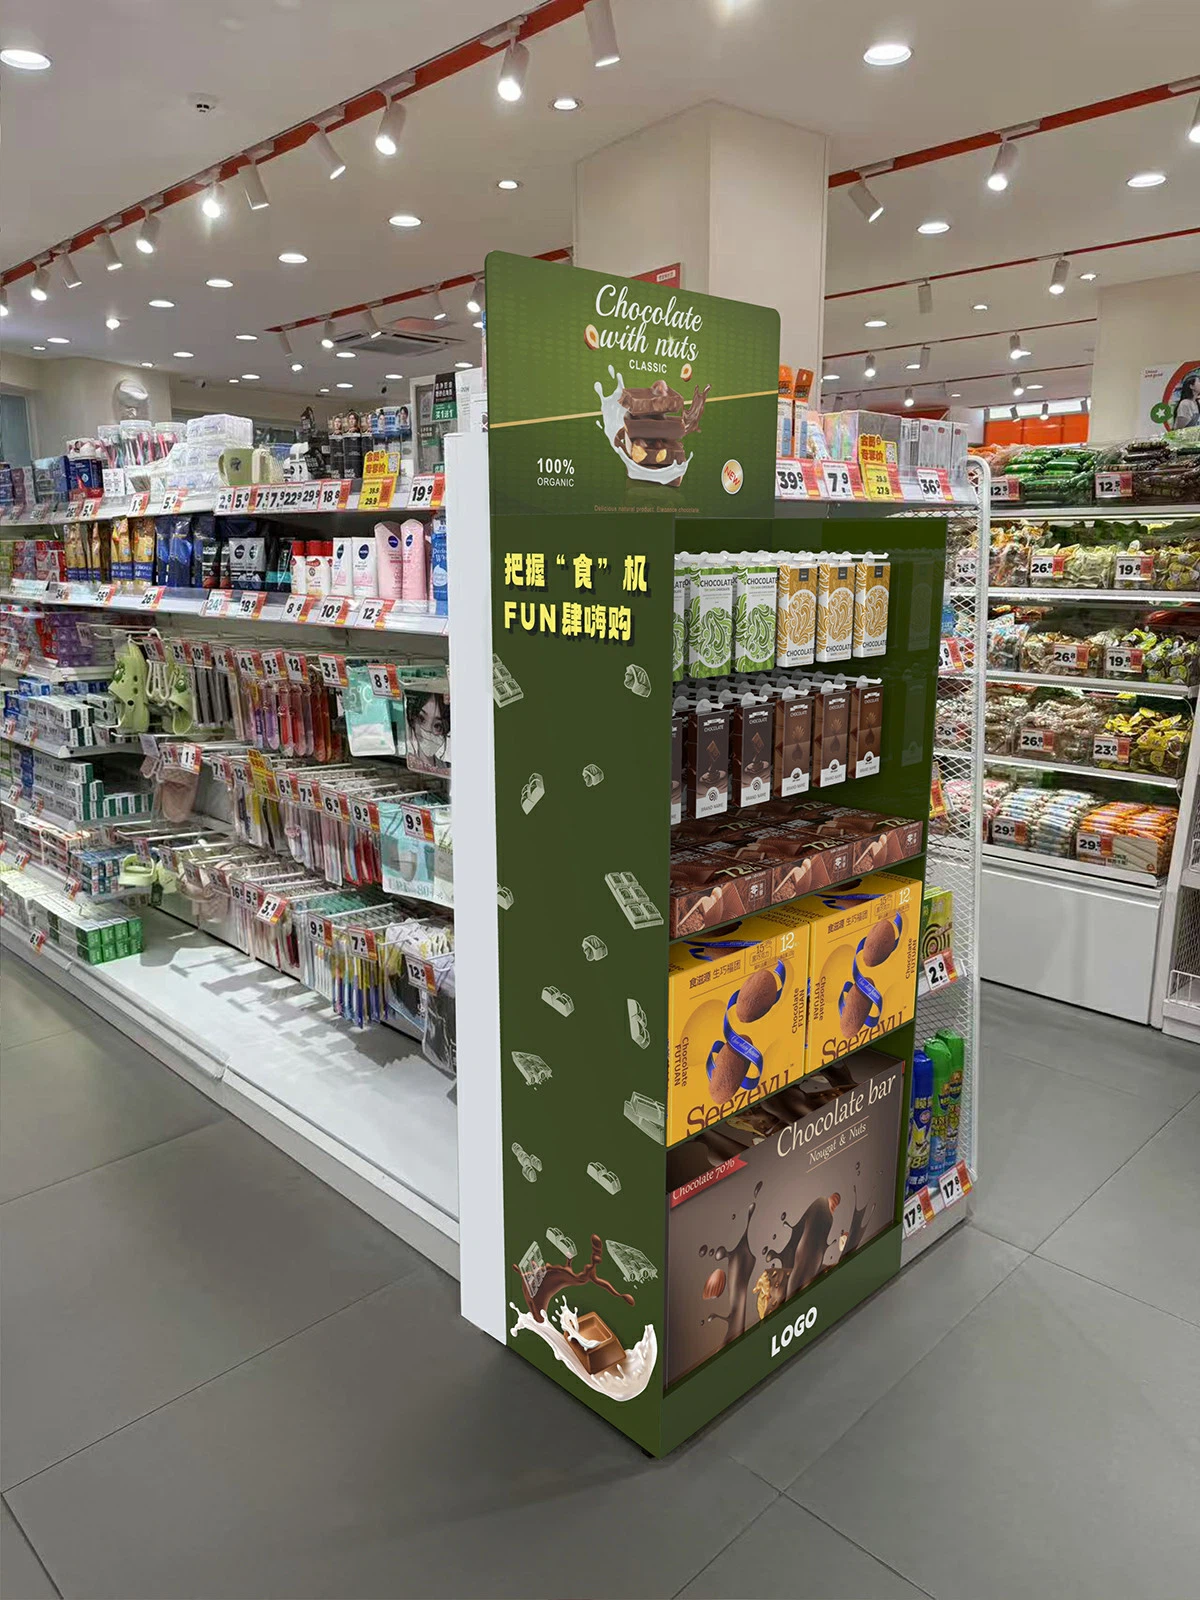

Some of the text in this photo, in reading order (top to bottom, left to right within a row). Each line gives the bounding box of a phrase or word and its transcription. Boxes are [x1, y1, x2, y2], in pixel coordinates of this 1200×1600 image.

[595, 284, 703, 332] Chocolate
[599, 322, 699, 361] with nuts
[629, 359, 667, 373] CLASSIC
[537, 457, 575, 475] 100%
[724, 465, 741, 486] NEW
[777, 470, 803, 490] 39.9
[412, 485, 434, 502] 19.9
[537, 476, 575, 488] ORGANIC
[405, 814, 422, 832] 9.9
[898, 887, 911, 906] 12
[780, 931, 795, 953] 12
[929, 961, 944, 985] 2.9
[791, 987, 800, 1034] Chocolate
[797, 988, 805, 1029] FUTUAN
[818, 975, 827, 1021] Chocolate
[674, 1043, 682, 1087] FUTUAN
[681, 1037, 690, 1088] Chocolate
[776, 1073, 897, 1158] Chocolate bar
[808, 1122, 867, 1165] Nougat & Nuts
[672, 1170, 714, 1201] Chocolate
[904, 1202, 922, 1228] 17.9
[771, 1306, 818, 1358] LOGO
